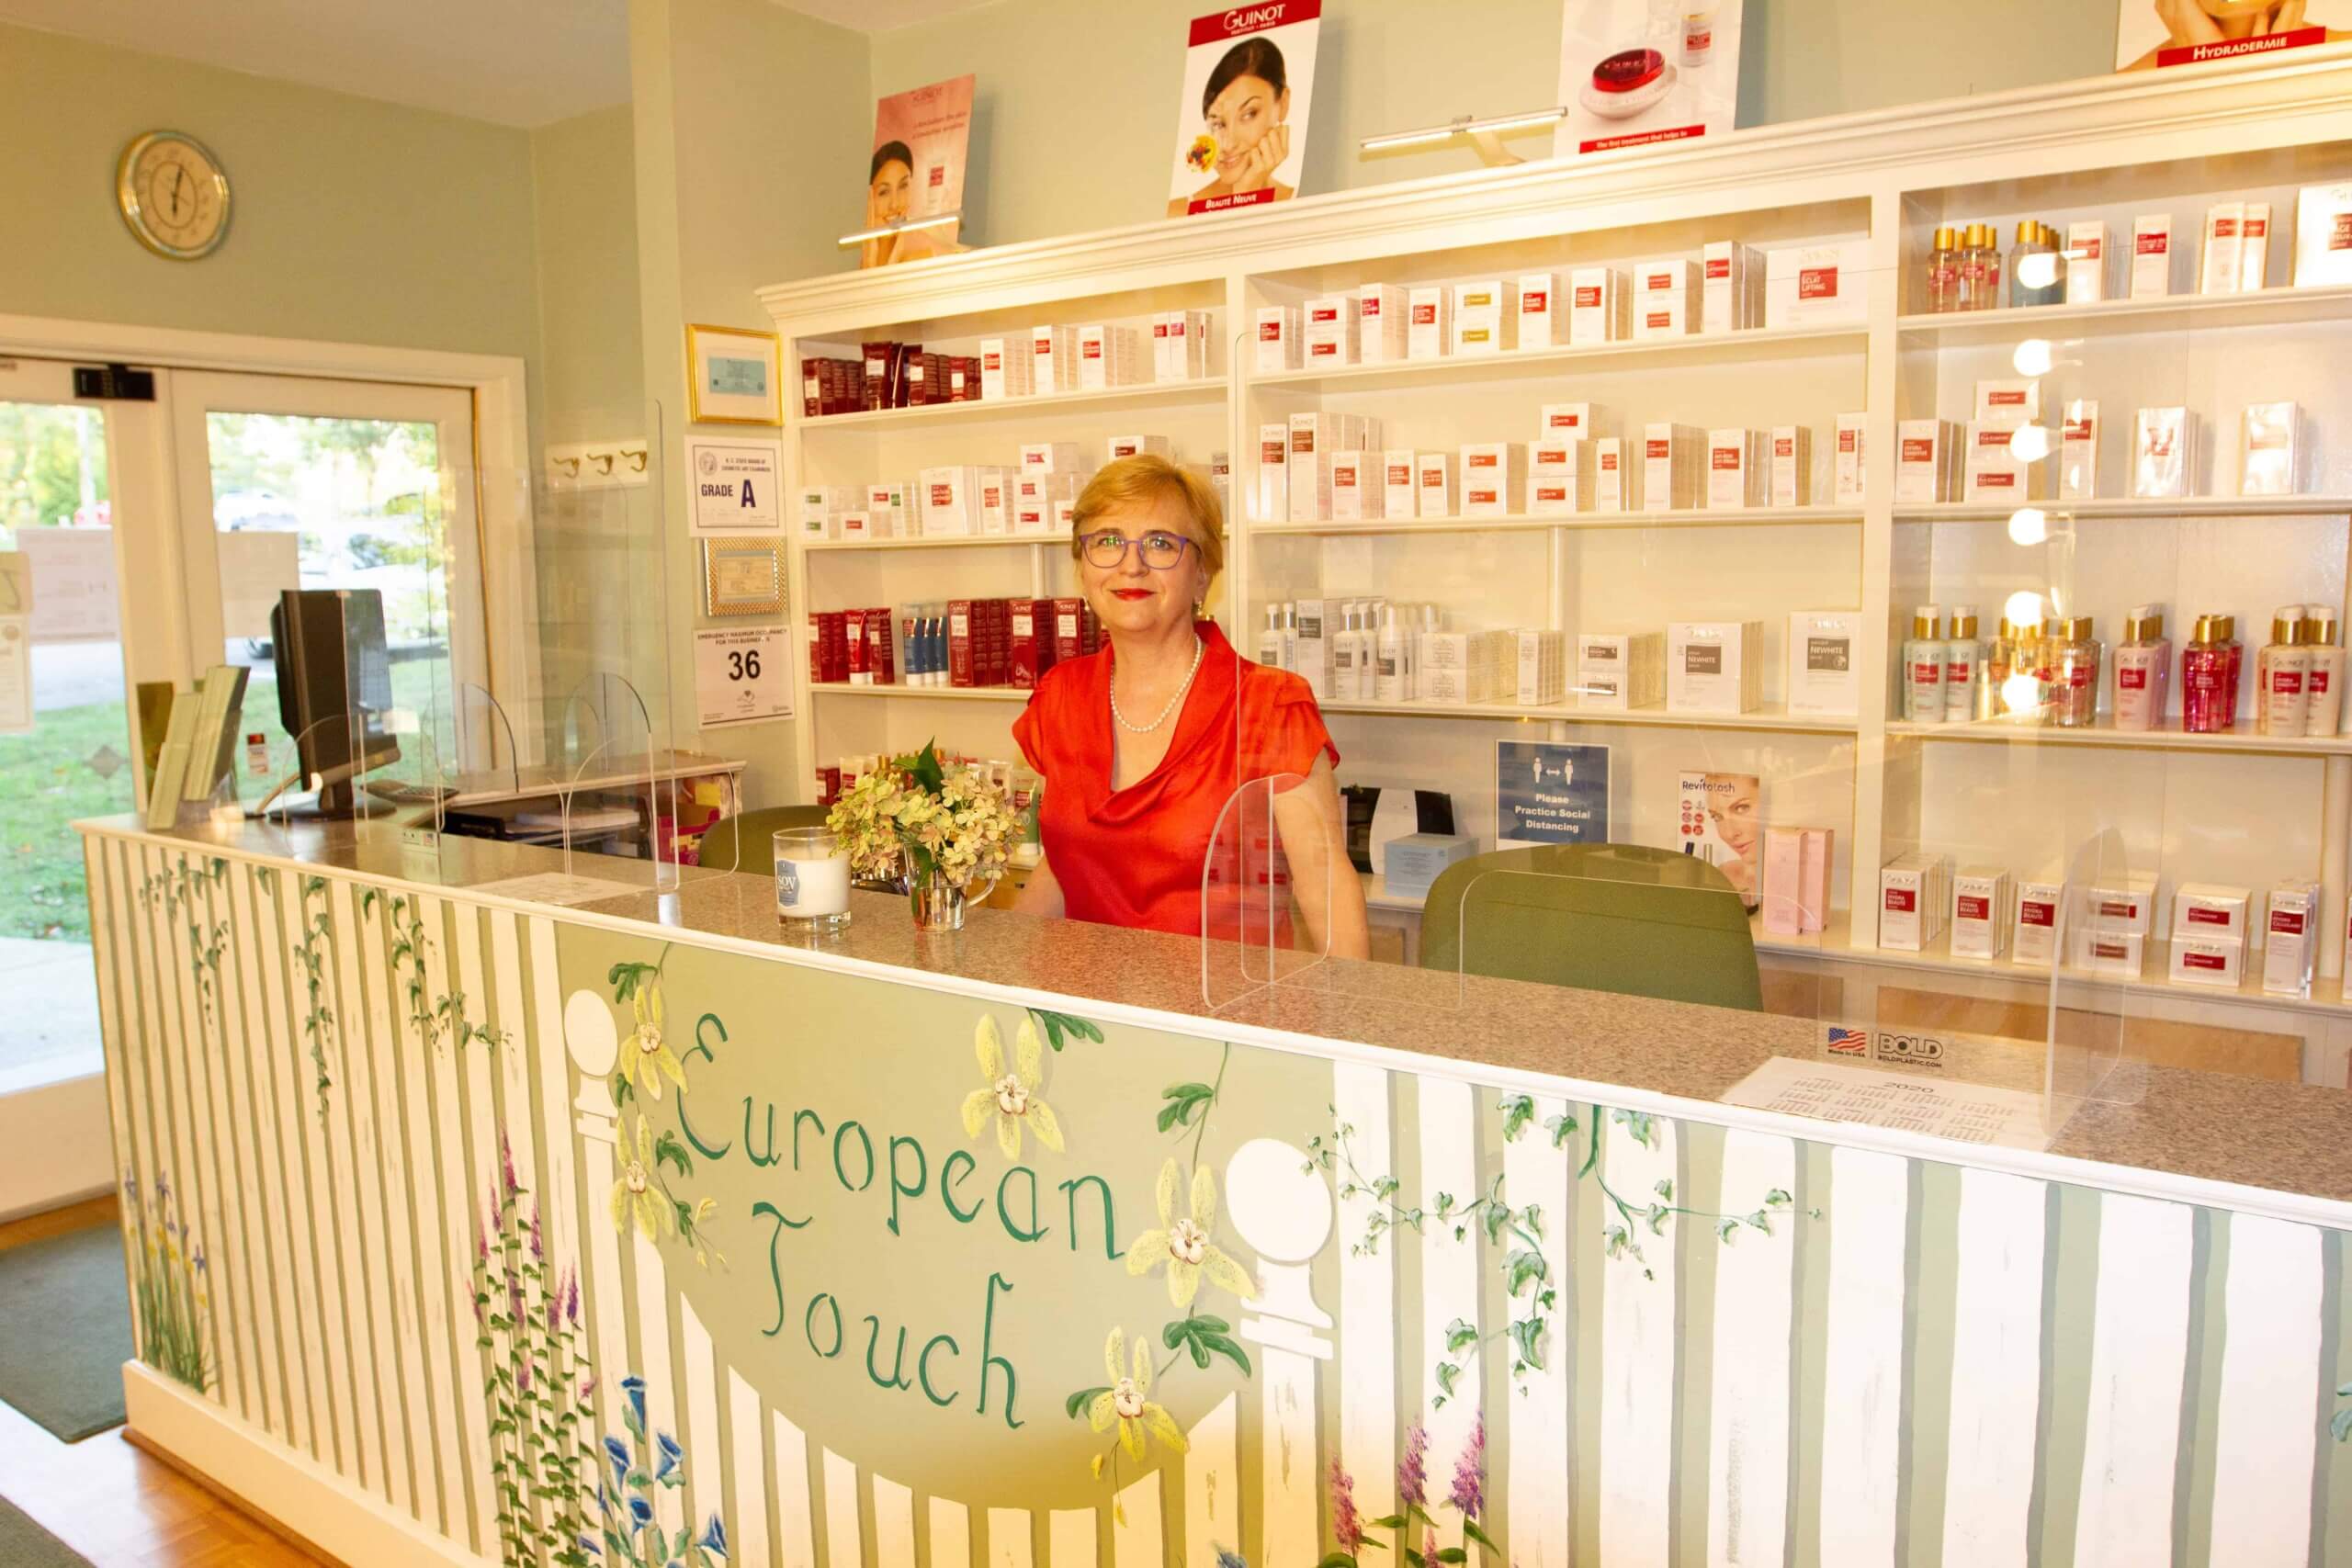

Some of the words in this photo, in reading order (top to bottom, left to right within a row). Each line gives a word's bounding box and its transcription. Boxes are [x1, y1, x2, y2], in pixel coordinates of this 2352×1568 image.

[1224, 4, 1285, 30] GUINOT
[2193, 37, 2287, 60] HYDRADERMIE
[701, 484, 733, 497] GRADE
[741, 479, 756, 507] A
[728, 650, 761, 681] 36
[1536, 794, 1569, 804] Please
[1515, 806, 1556, 816] Practice
[1559, 809, 1590, 819] Social
[1526, 819, 1578, 833] Distancing
[1879, 1033, 1943, 1059] BOLD
[1878, 1055, 1941, 1068] BOLDPLASTIC.COM
[1883, 1081, 1934, 1093] 2020
[677, 1012, 1125, 1259] European
[752, 1201, 1024, 1429] Touch
